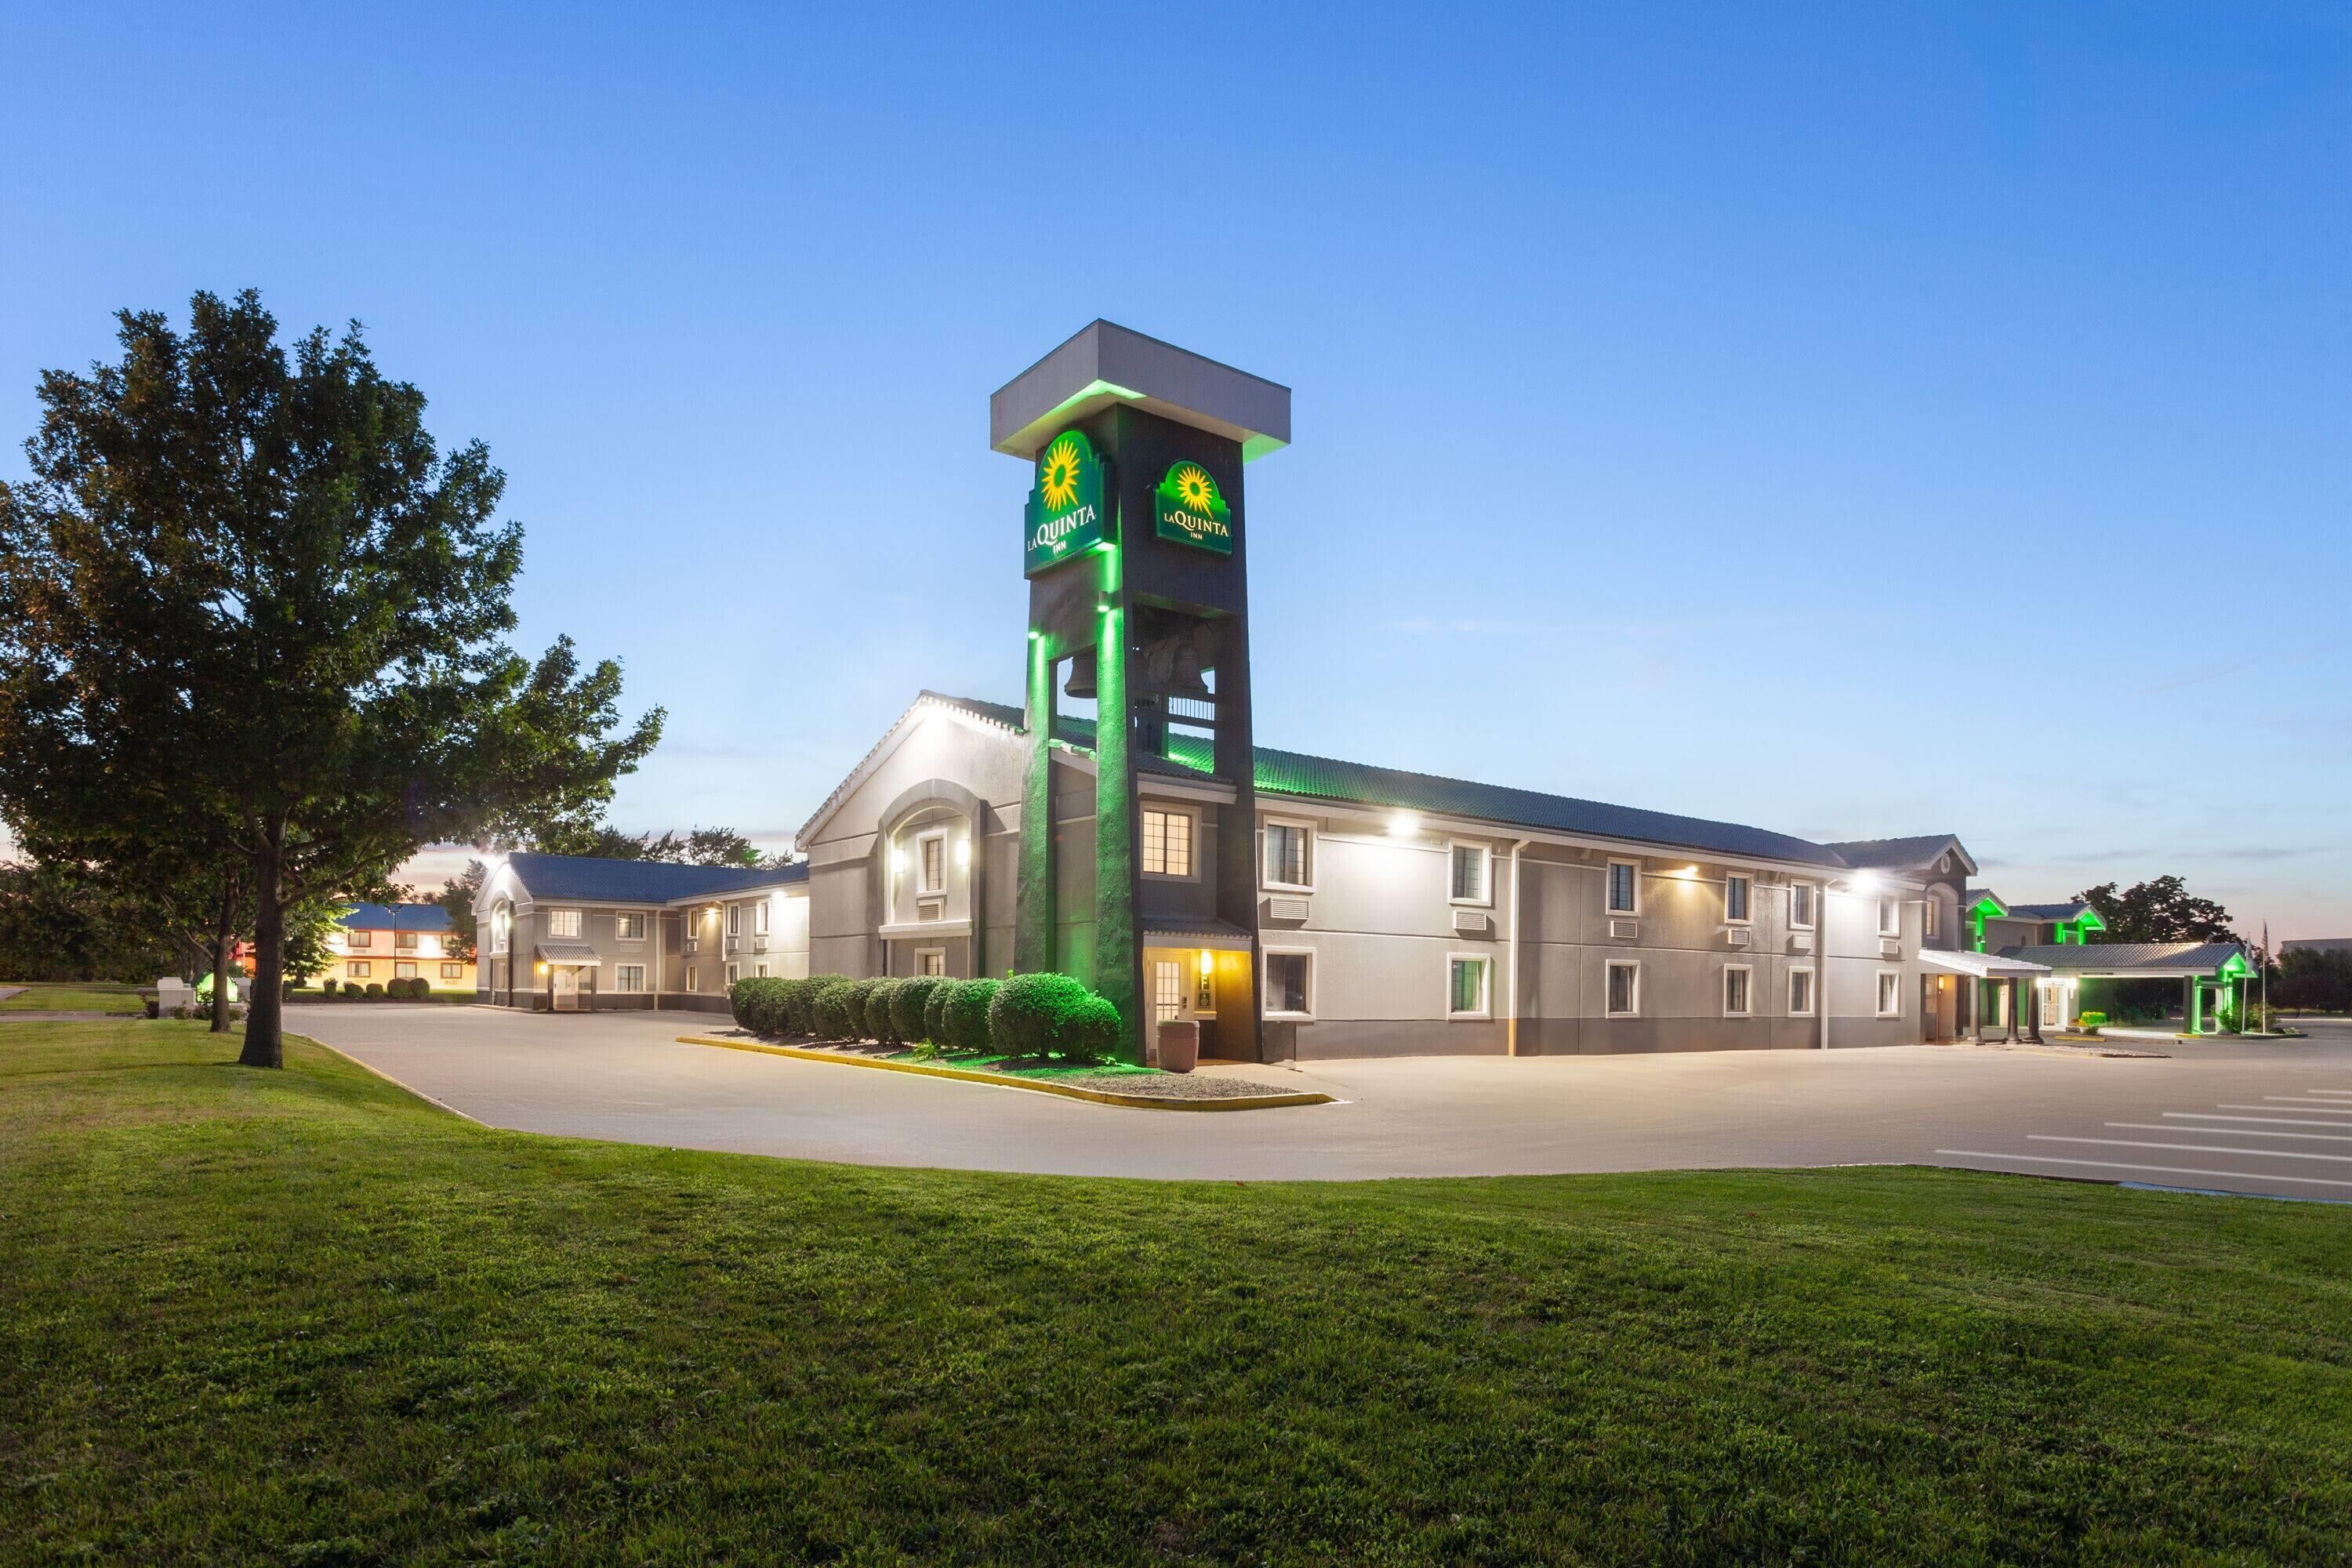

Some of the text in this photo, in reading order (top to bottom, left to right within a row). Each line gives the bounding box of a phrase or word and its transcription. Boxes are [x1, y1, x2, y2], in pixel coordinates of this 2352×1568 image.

[1028, 504, 1096, 552] LA QUINTA
[1164, 510, 1229, 537] LA QUINTA
[1190, 532, 1203, 540] INN
[1053, 540, 1066, 554] INN
[1201, 976, 1208, 989] F
